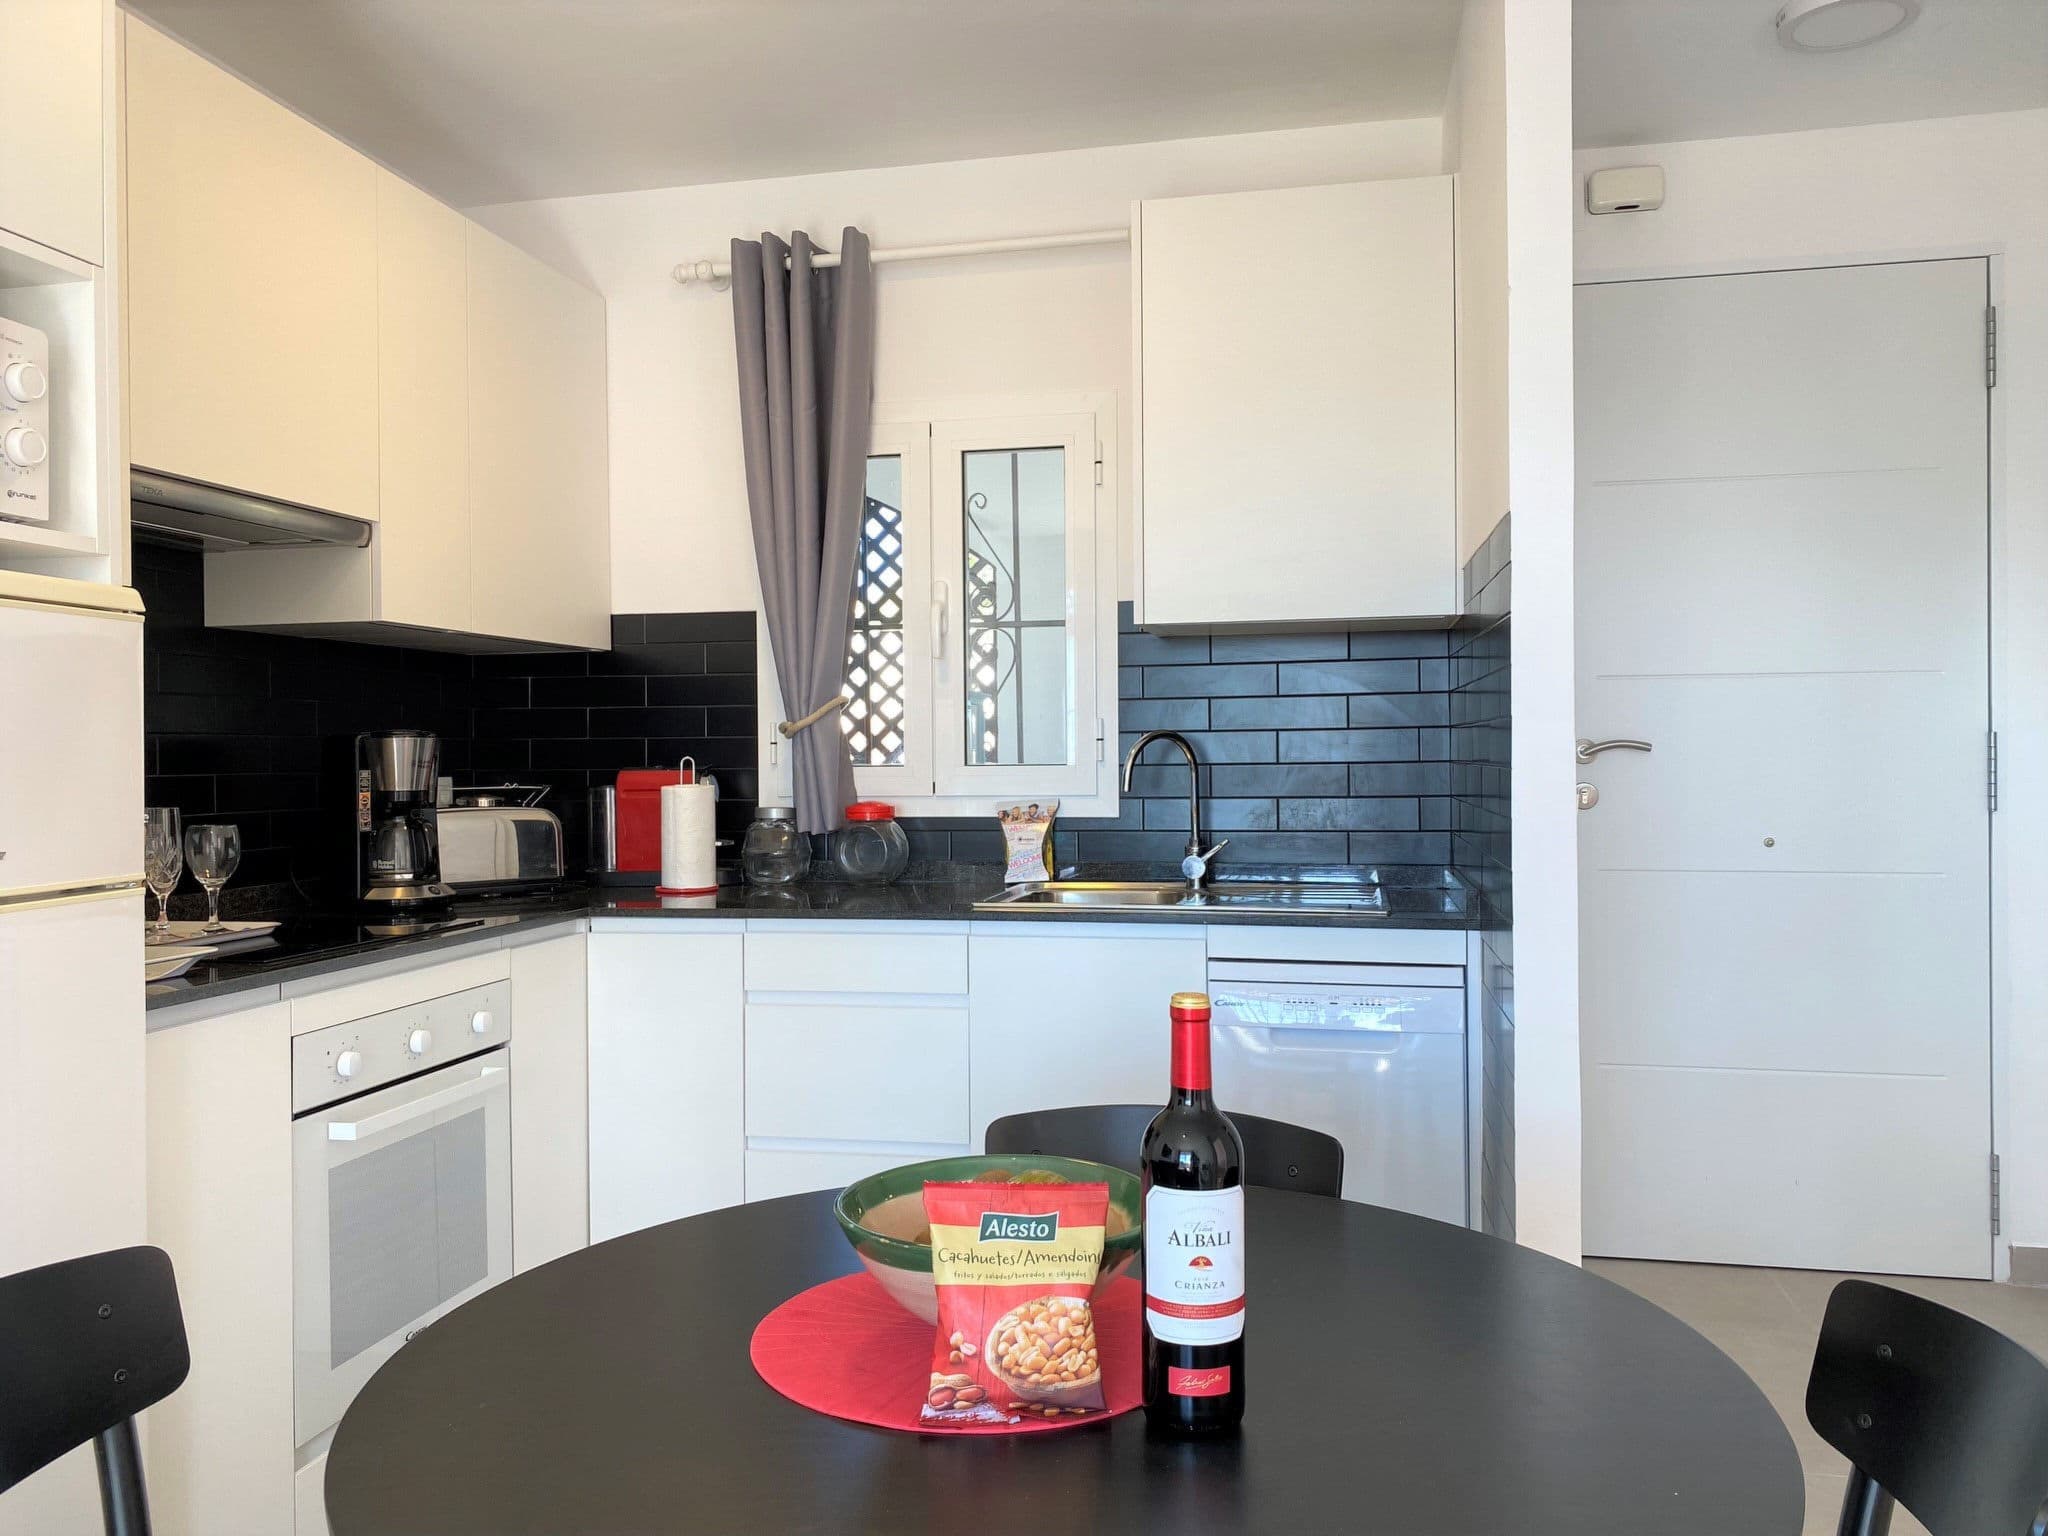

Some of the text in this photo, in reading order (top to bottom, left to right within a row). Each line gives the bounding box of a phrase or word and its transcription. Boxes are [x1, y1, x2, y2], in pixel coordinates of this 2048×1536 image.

[985, 1218, 1050, 1237] Alesto
[1168, 1230, 1232, 1248] ALBALI
[1174, 1280, 1225, 1290] CRIANZA
